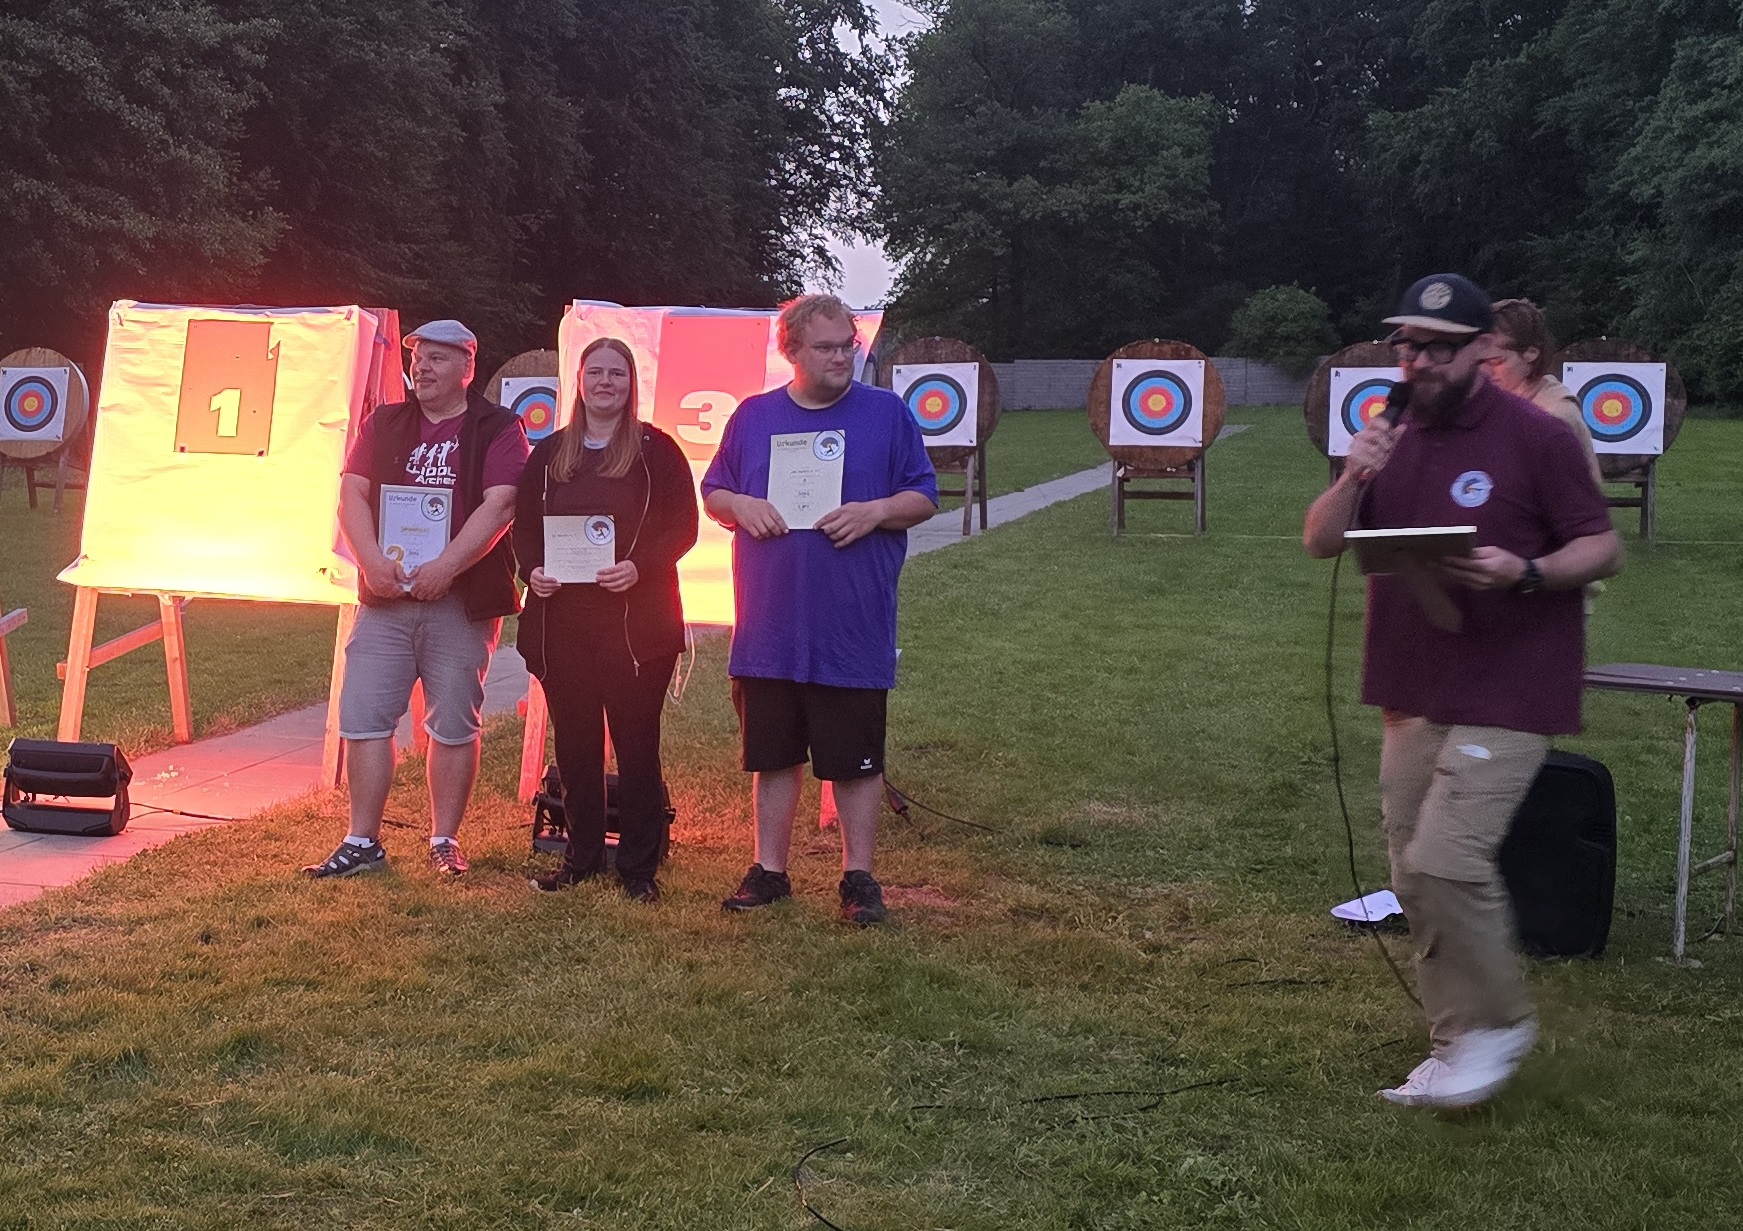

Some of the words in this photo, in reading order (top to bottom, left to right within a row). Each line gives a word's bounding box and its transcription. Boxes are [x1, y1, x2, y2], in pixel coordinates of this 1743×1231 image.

[209, 387, 242, 437] 1
[676, 389, 738, 446] 3
[776, 439, 808, 447] Urkunde
[388, 494, 418, 503] Urkunde
